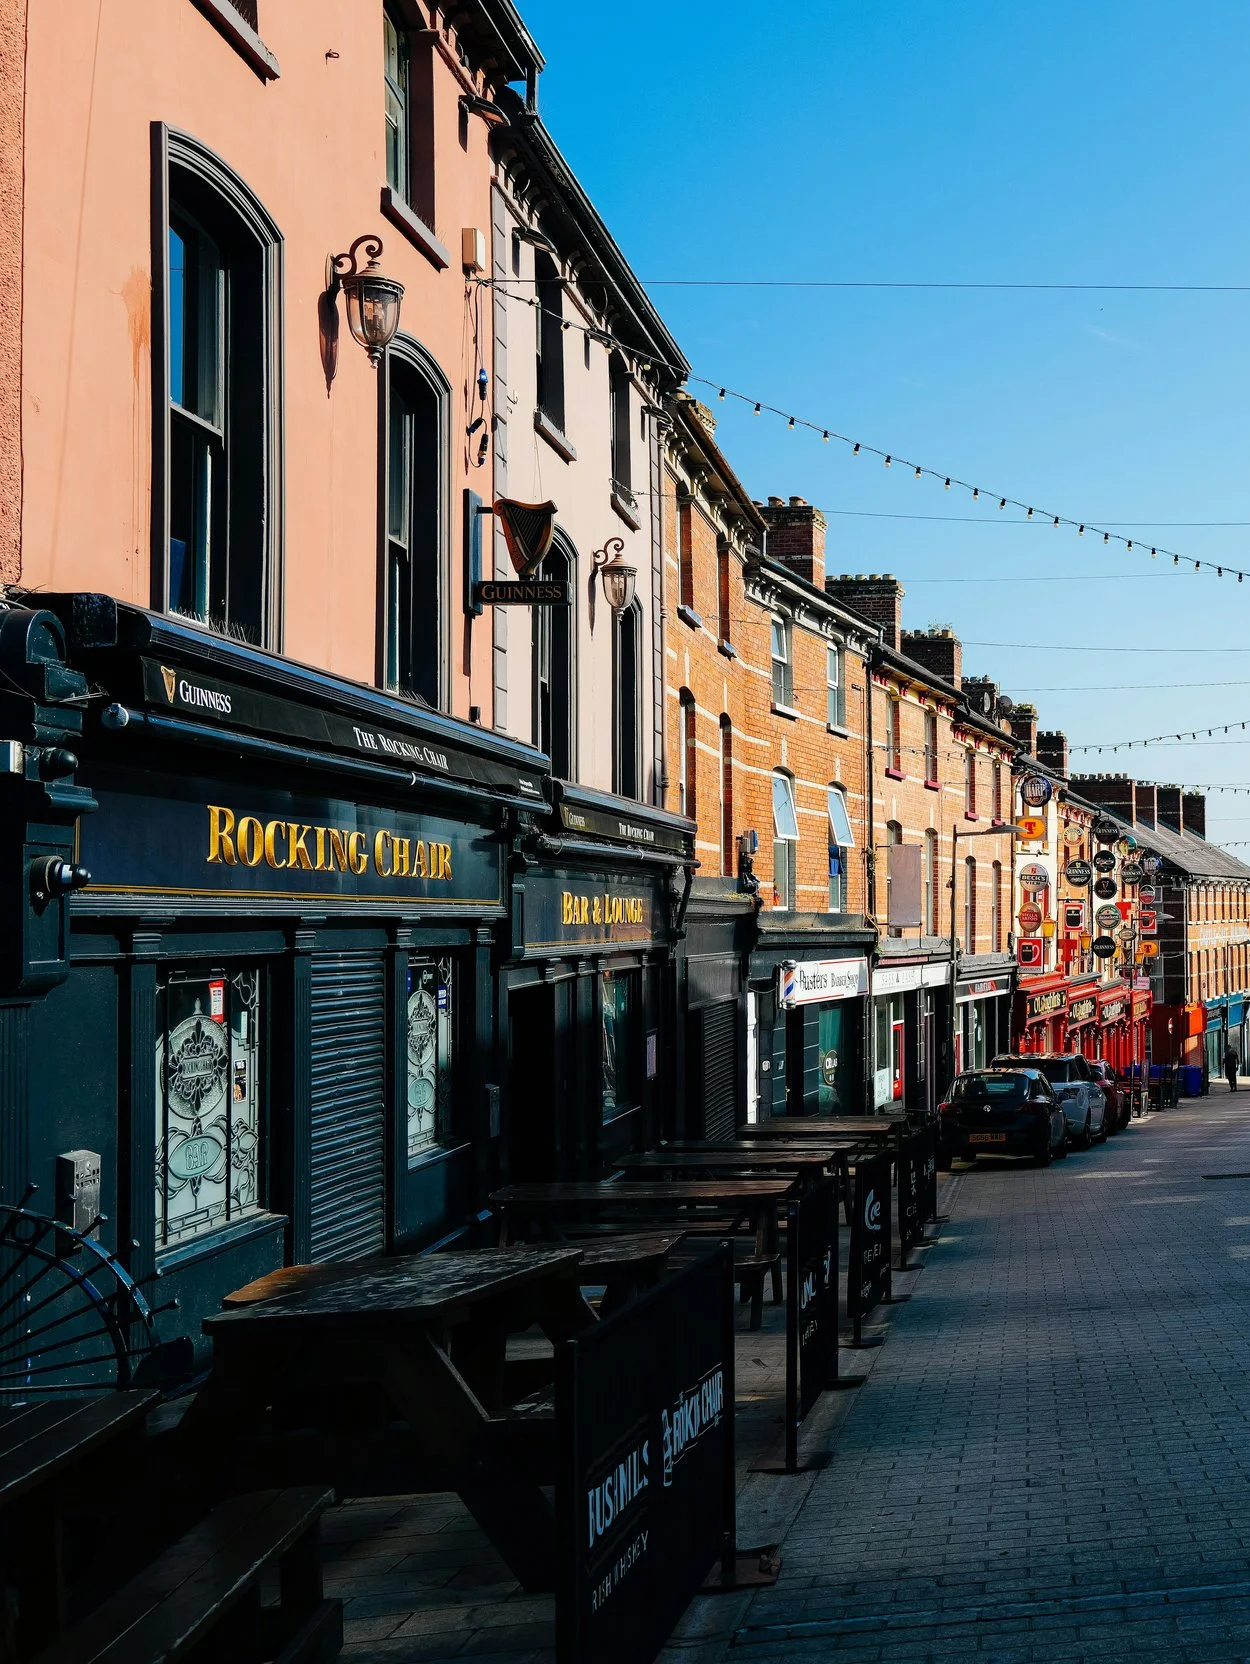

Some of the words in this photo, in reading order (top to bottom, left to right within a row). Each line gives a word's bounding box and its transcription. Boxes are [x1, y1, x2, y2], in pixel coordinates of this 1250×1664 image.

[481, 584, 562, 600] GUINNESS
[179, 679, 232, 714] GUINNESS
[353, 727, 377, 751] THE
[381, 732, 423, 762] ROCKING
[422, 746, 450, 771] CHAIR
[205, 804, 369, 875] ROCKING
[373, 829, 453, 881] CHAIR
[562, 891, 589, 925] BAR
[592, 896, 602, 925] &
[603, 893, 643, 924] LOUNGE
